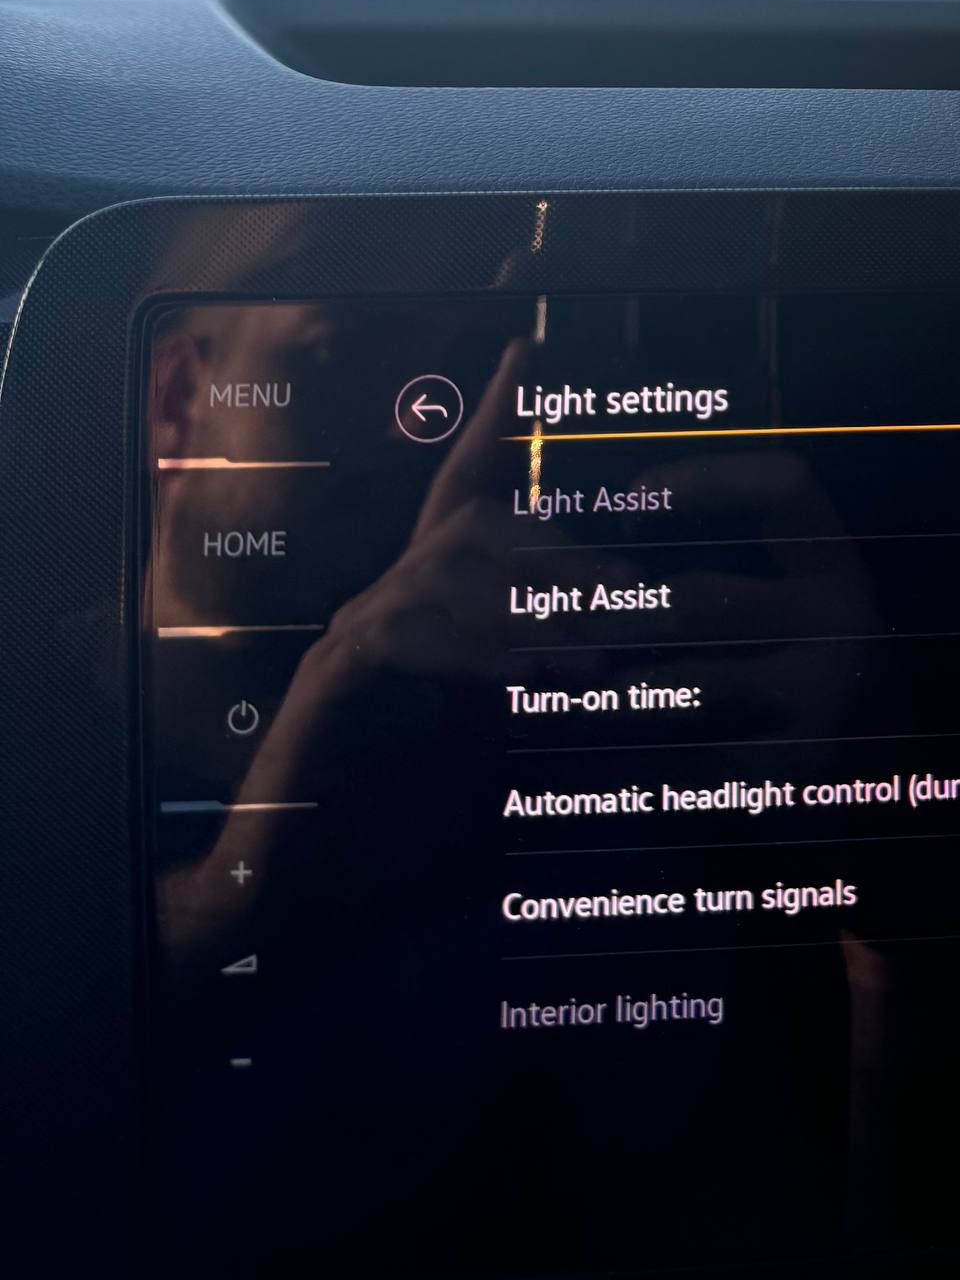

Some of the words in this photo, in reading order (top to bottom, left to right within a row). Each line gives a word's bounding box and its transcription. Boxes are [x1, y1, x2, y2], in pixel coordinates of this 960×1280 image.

[207, 380, 293, 410] MENU
[515, 383, 598, 423] Light
[605, 381, 730, 421] settings
[512, 486, 586, 523] Light
[592, 484, 673, 513] Assist
[202, 529, 288, 558] HOME
[509, 584, 583, 621] Light
[588, 581, 672, 612] Assist
[505, 684, 620, 715] Turn-on
[626, 681, 702, 711] time:
[502, 784, 655, 818] Automatic
[661, 779, 797, 816] headlight
[801, 773, 901, 807] control
[501, 887, 687, 922] Convenience
[692, 887, 755, 913] turn
[760, 877, 858, 916] signals
[500, 996, 608, 1029] Interior
[615, 991, 725, 1030] lighting
